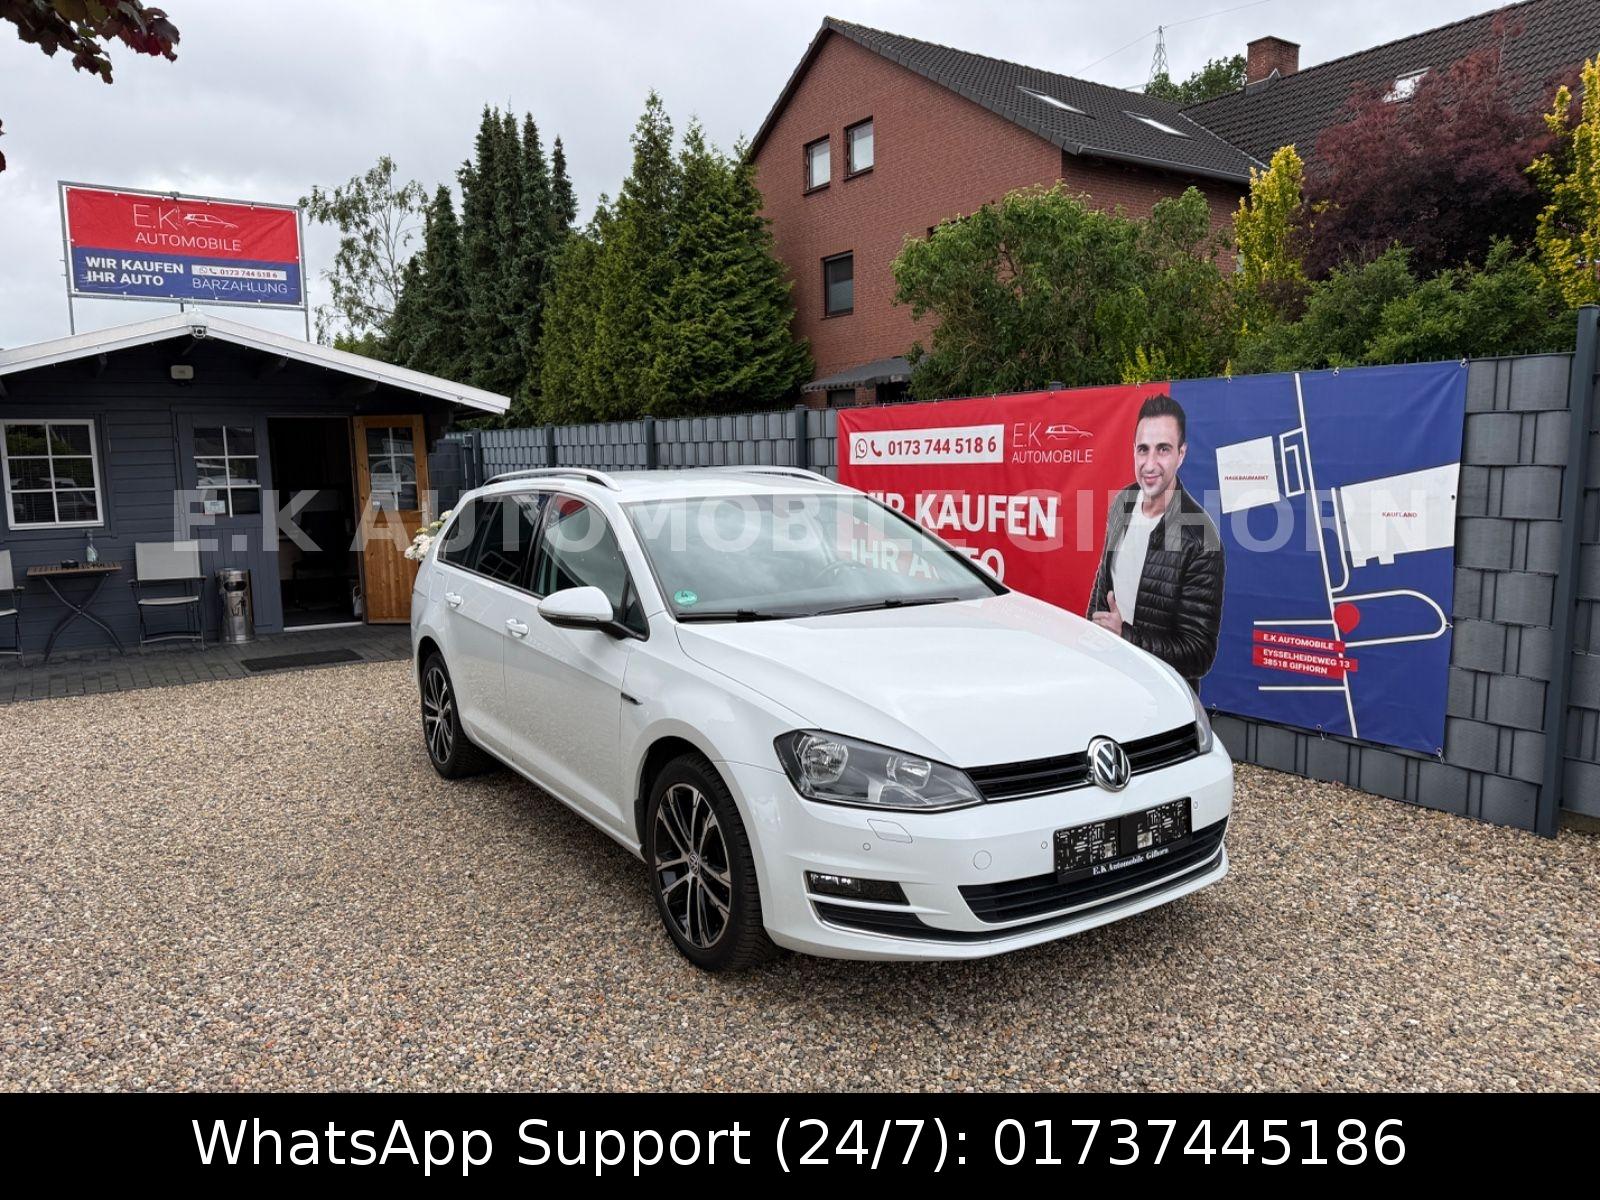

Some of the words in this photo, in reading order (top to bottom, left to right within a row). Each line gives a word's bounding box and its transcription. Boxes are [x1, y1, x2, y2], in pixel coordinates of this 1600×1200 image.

[133, 204, 178, 230] E.K
[135, 232, 242, 252] AUTOMOBILE
[86, 256, 117, 270] WIR
[121, 259, 184, 274] KAUFEN
[87, 272, 116, 284] IHR
[119, 273, 164, 287] AUTO
[192, 278, 288, 294] BARZAHLUNG
[1012, 422, 1042, 448] E.K
[888, 440, 921, 456] 0173
[925, 438, 951, 455] 744
[955, 436, 984, 454] 518
[987, 436, 997, 453] 6
[1012, 448, 1093, 464] AUTOMOBILE
[914, 493, 1058, 538] KAUFEN
[850, 538, 900, 573] IHR
[1263, 633, 1277, 642] E.K
[1278, 636, 1335, 650] AUTOMOBILE
[1263, 648, 1337, 666] EYSSELHEIDEWEG
[1339, 660, 1350, 668] 13
[1263, 658, 1288, 668] 38518
[1289, 662, 1328, 675] GIFHORN
[1109, 855, 1144, 870] Automobile
[1146, 848, 1169, 859] Gifhorn
